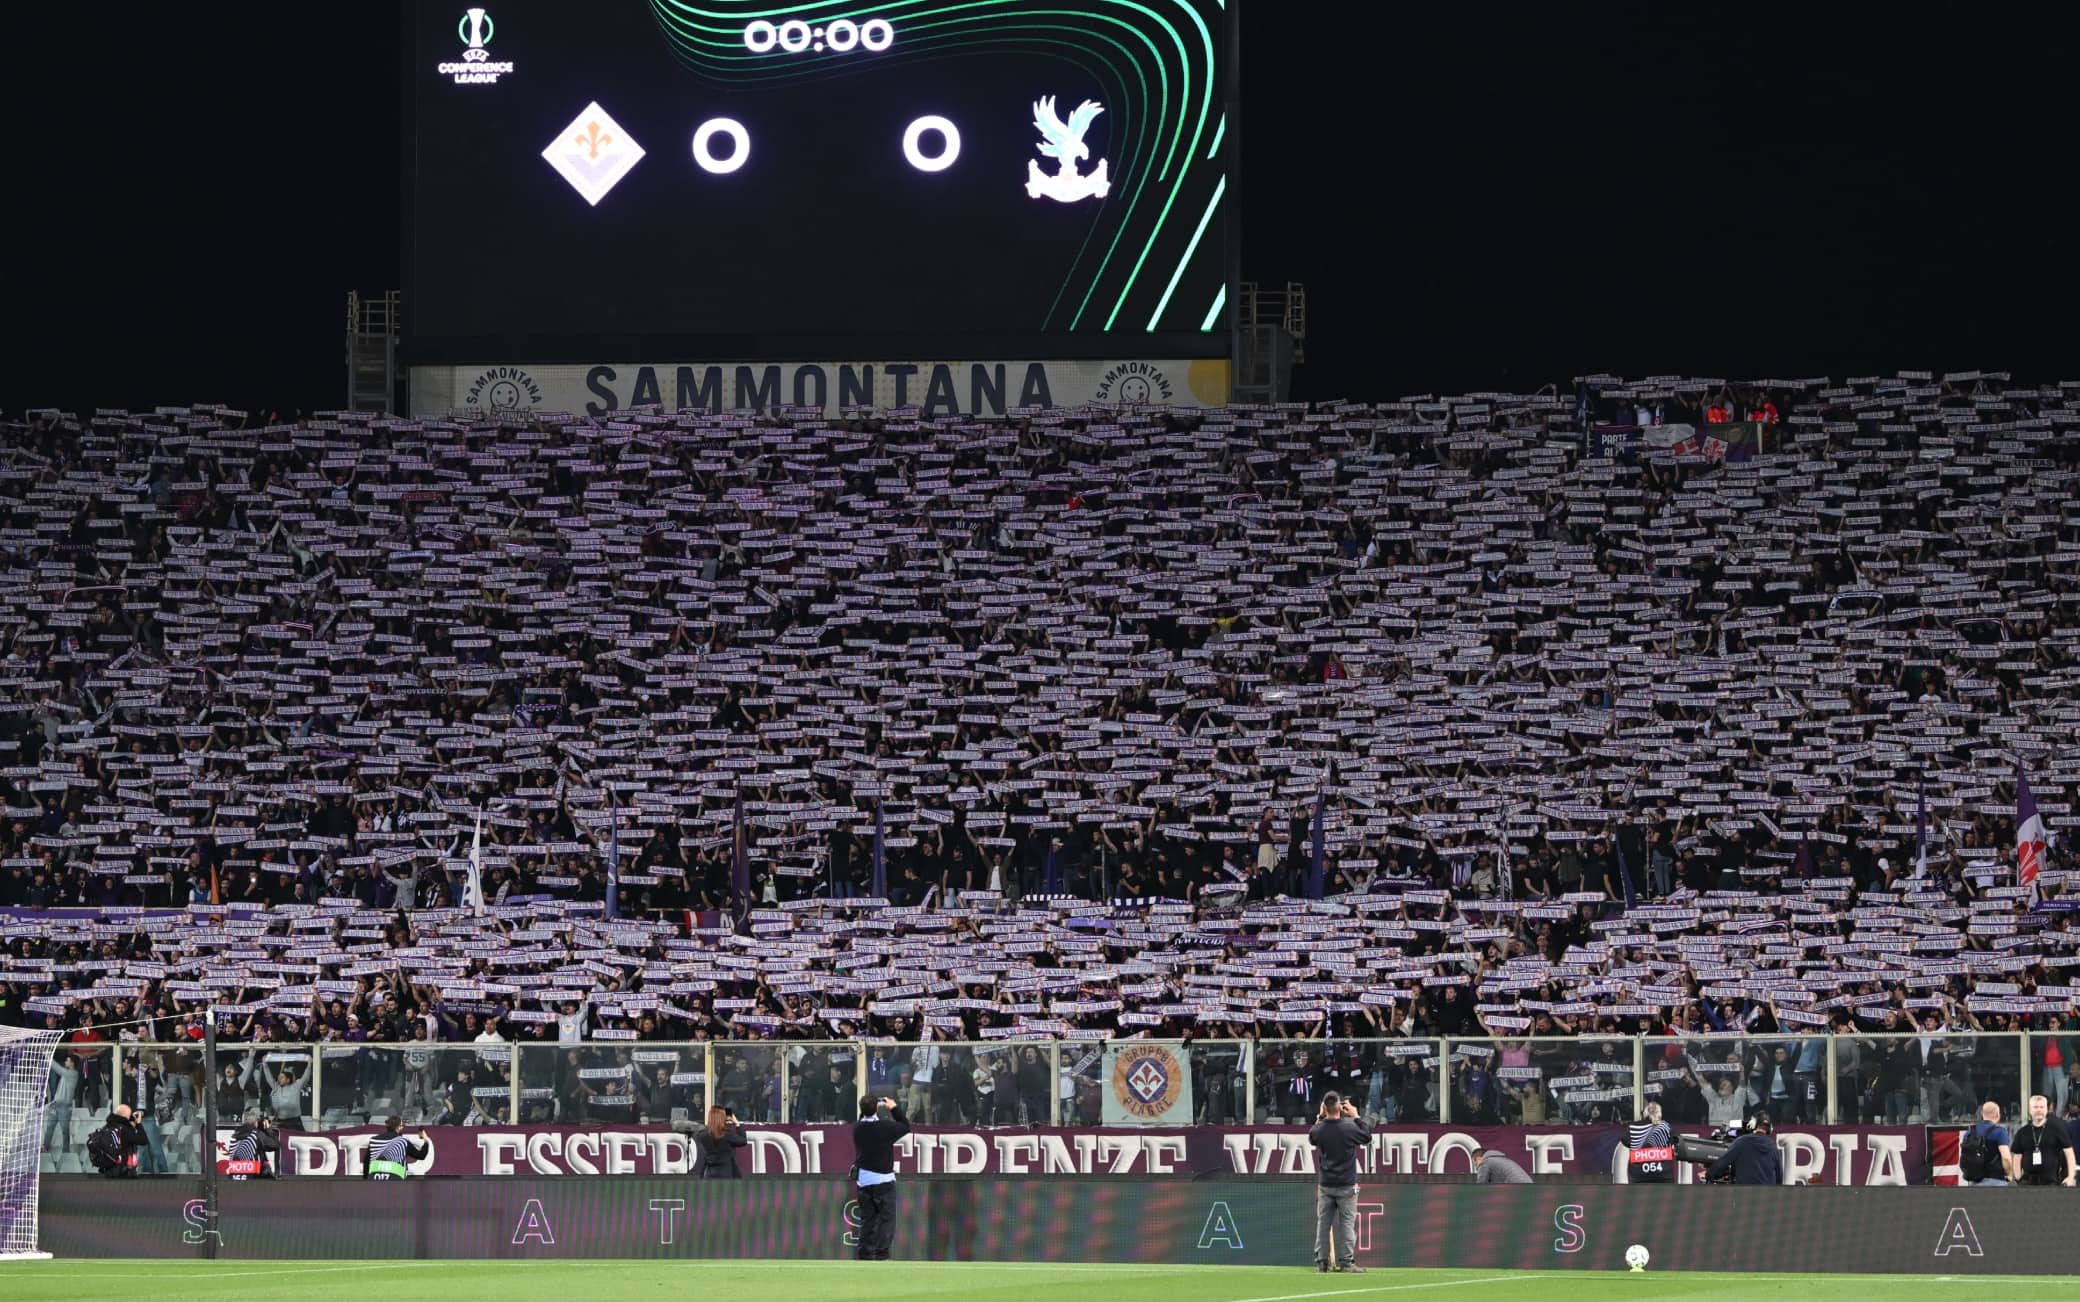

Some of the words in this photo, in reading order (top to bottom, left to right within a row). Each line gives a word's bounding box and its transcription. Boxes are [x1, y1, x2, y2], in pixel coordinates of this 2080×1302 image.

[744, 19, 894, 53] 00:00
[438, 62, 514, 74] CONFERENCE
[454, 73, 498, 84] LEAGUE
[692, 117, 751, 174] 0
[902, 115, 961, 172] 0
[466, 367, 543, 405] SAMMONTANA
[586, 362, 1053, 418] SAMMONTANA
[1096, 361, 1174, 400] SAMMONTANA
[1634, 1149, 1668, 1161] PHOTO
[1641, 1161, 1663, 1173] 054
[512, 1198, 555, 1245] A
[649, 1198, 685, 1245] T
[1197, 1200, 1244, 1249] A
[1554, 1203, 1586, 1253] S
[1934, 1207, 1985, 1257] A
